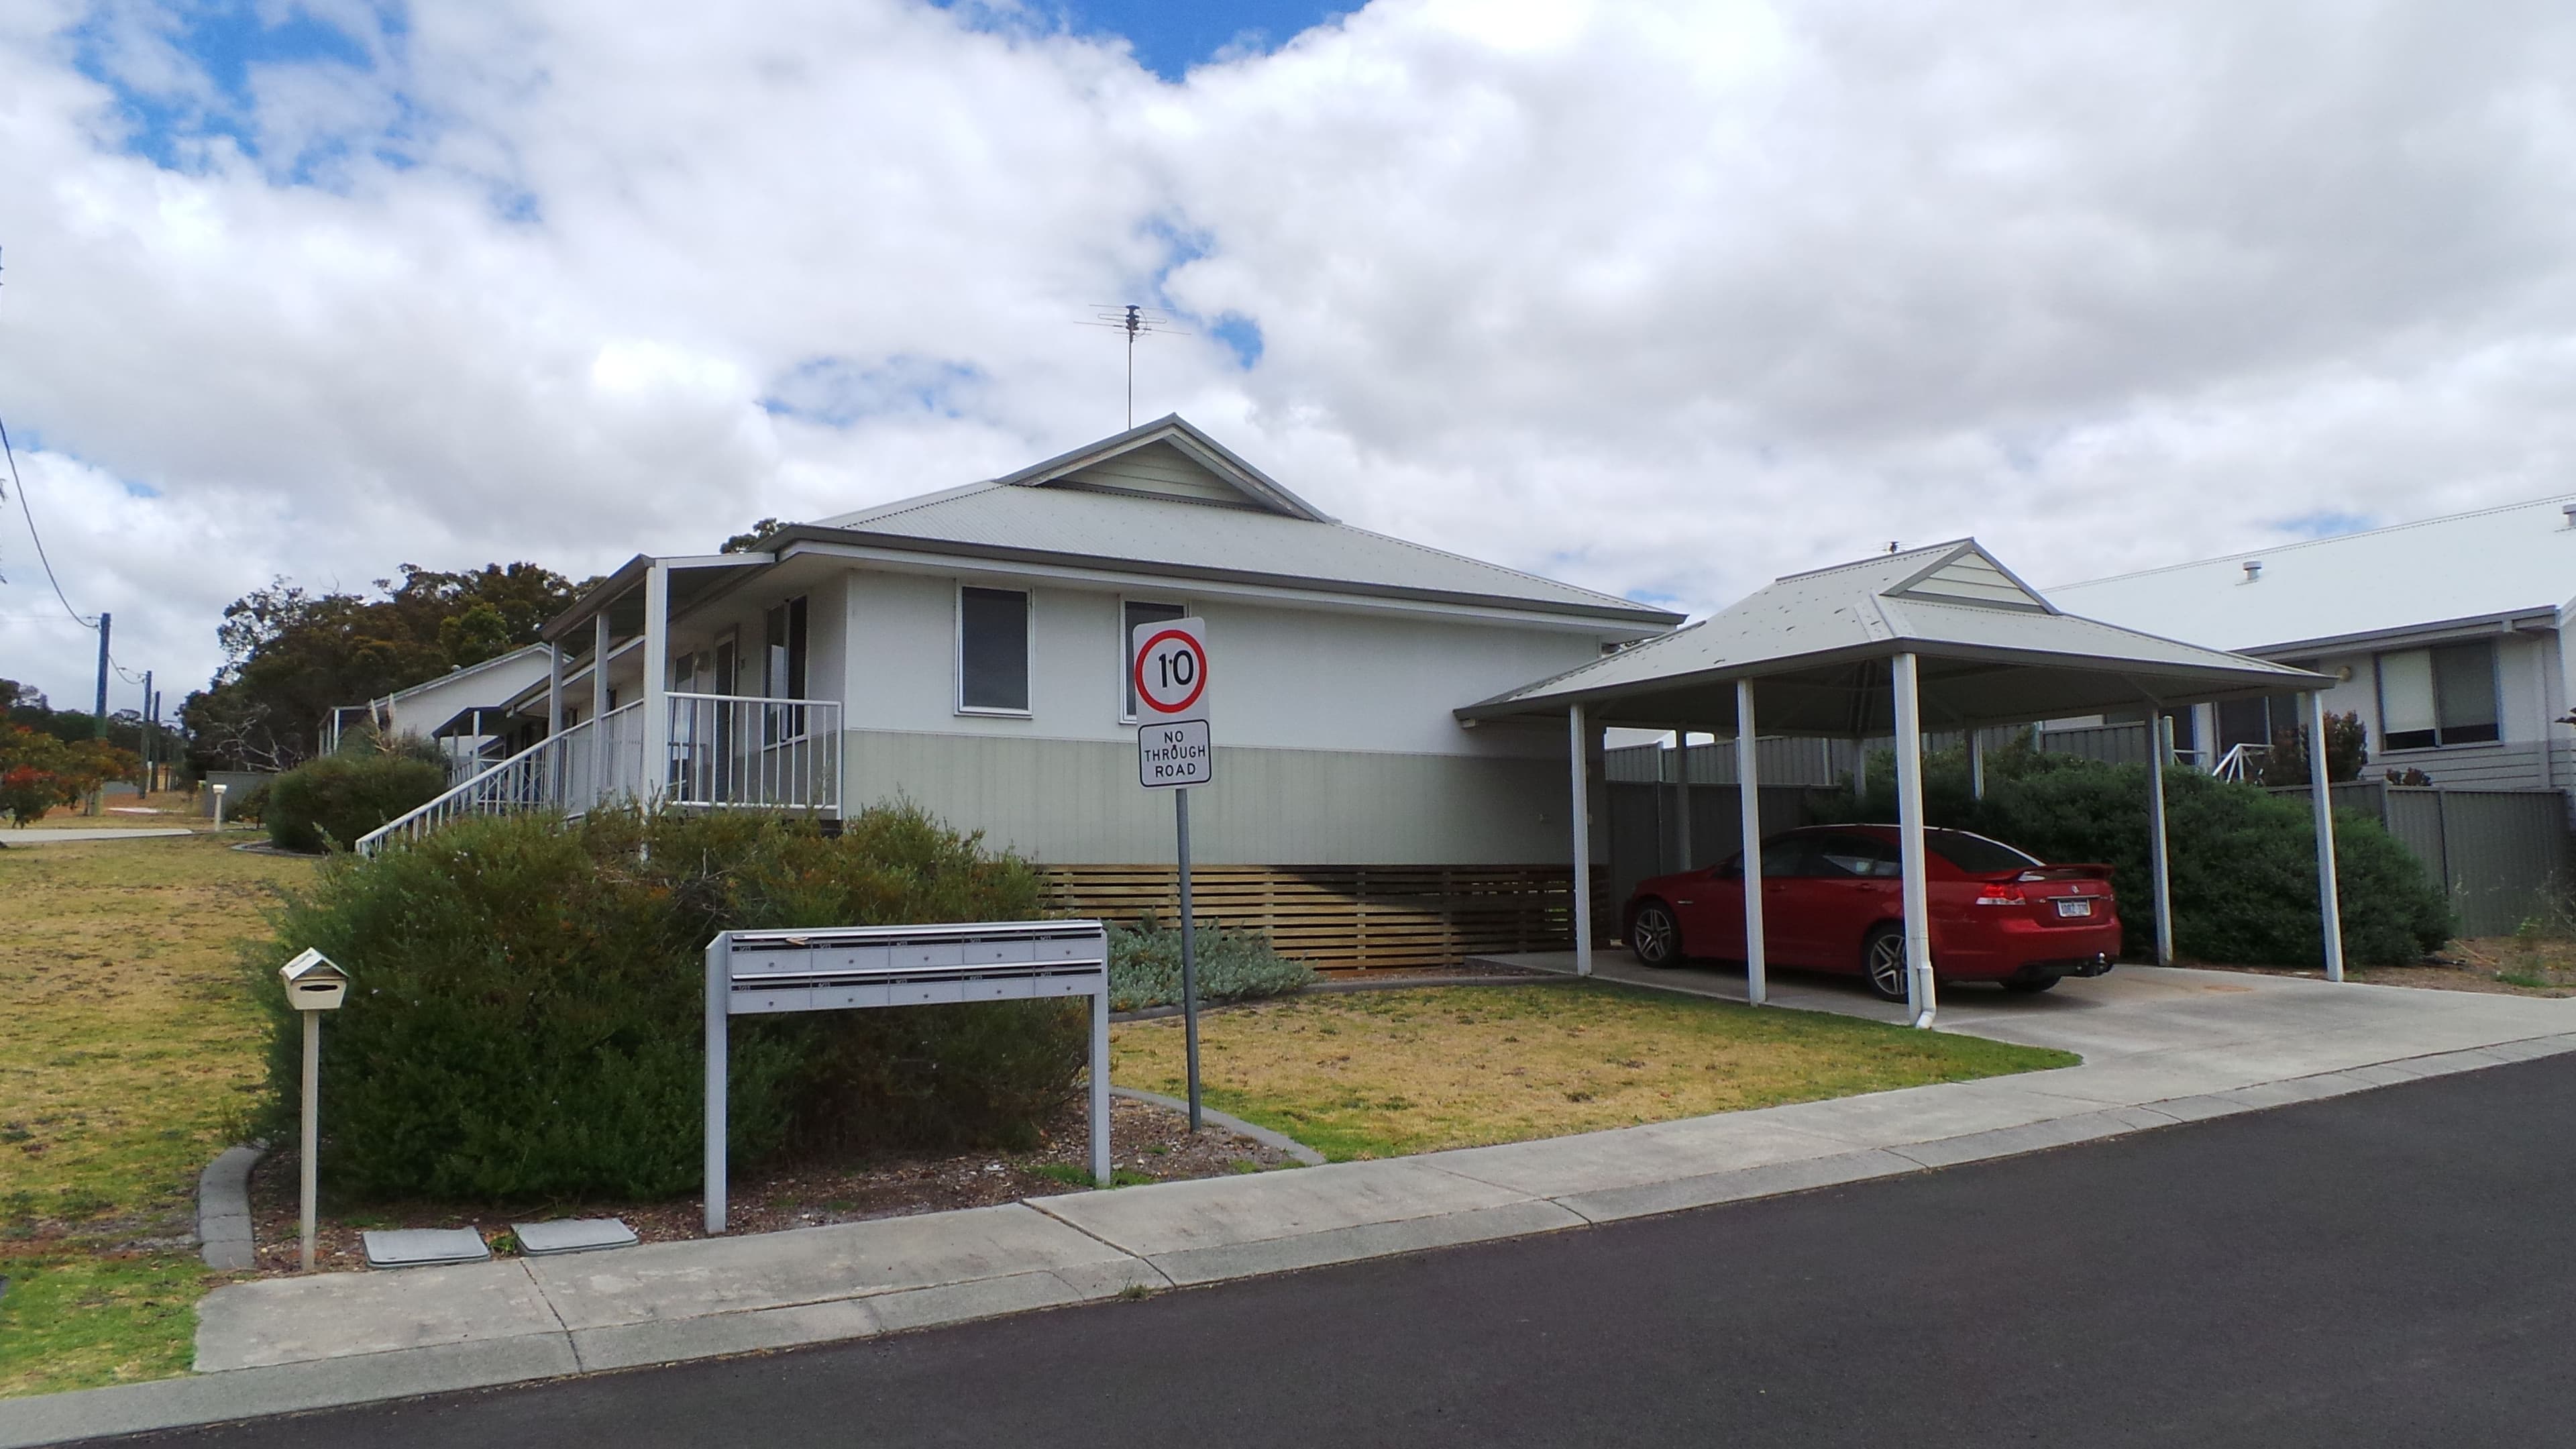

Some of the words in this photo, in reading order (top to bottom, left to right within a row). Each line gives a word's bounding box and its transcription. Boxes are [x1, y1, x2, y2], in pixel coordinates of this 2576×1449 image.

[1159, 650, 1194, 688] 10
[1164, 731, 1183, 743] NO
[1144, 745, 1205, 762] THROUGH
[1155, 763, 1196, 777] ROAD
